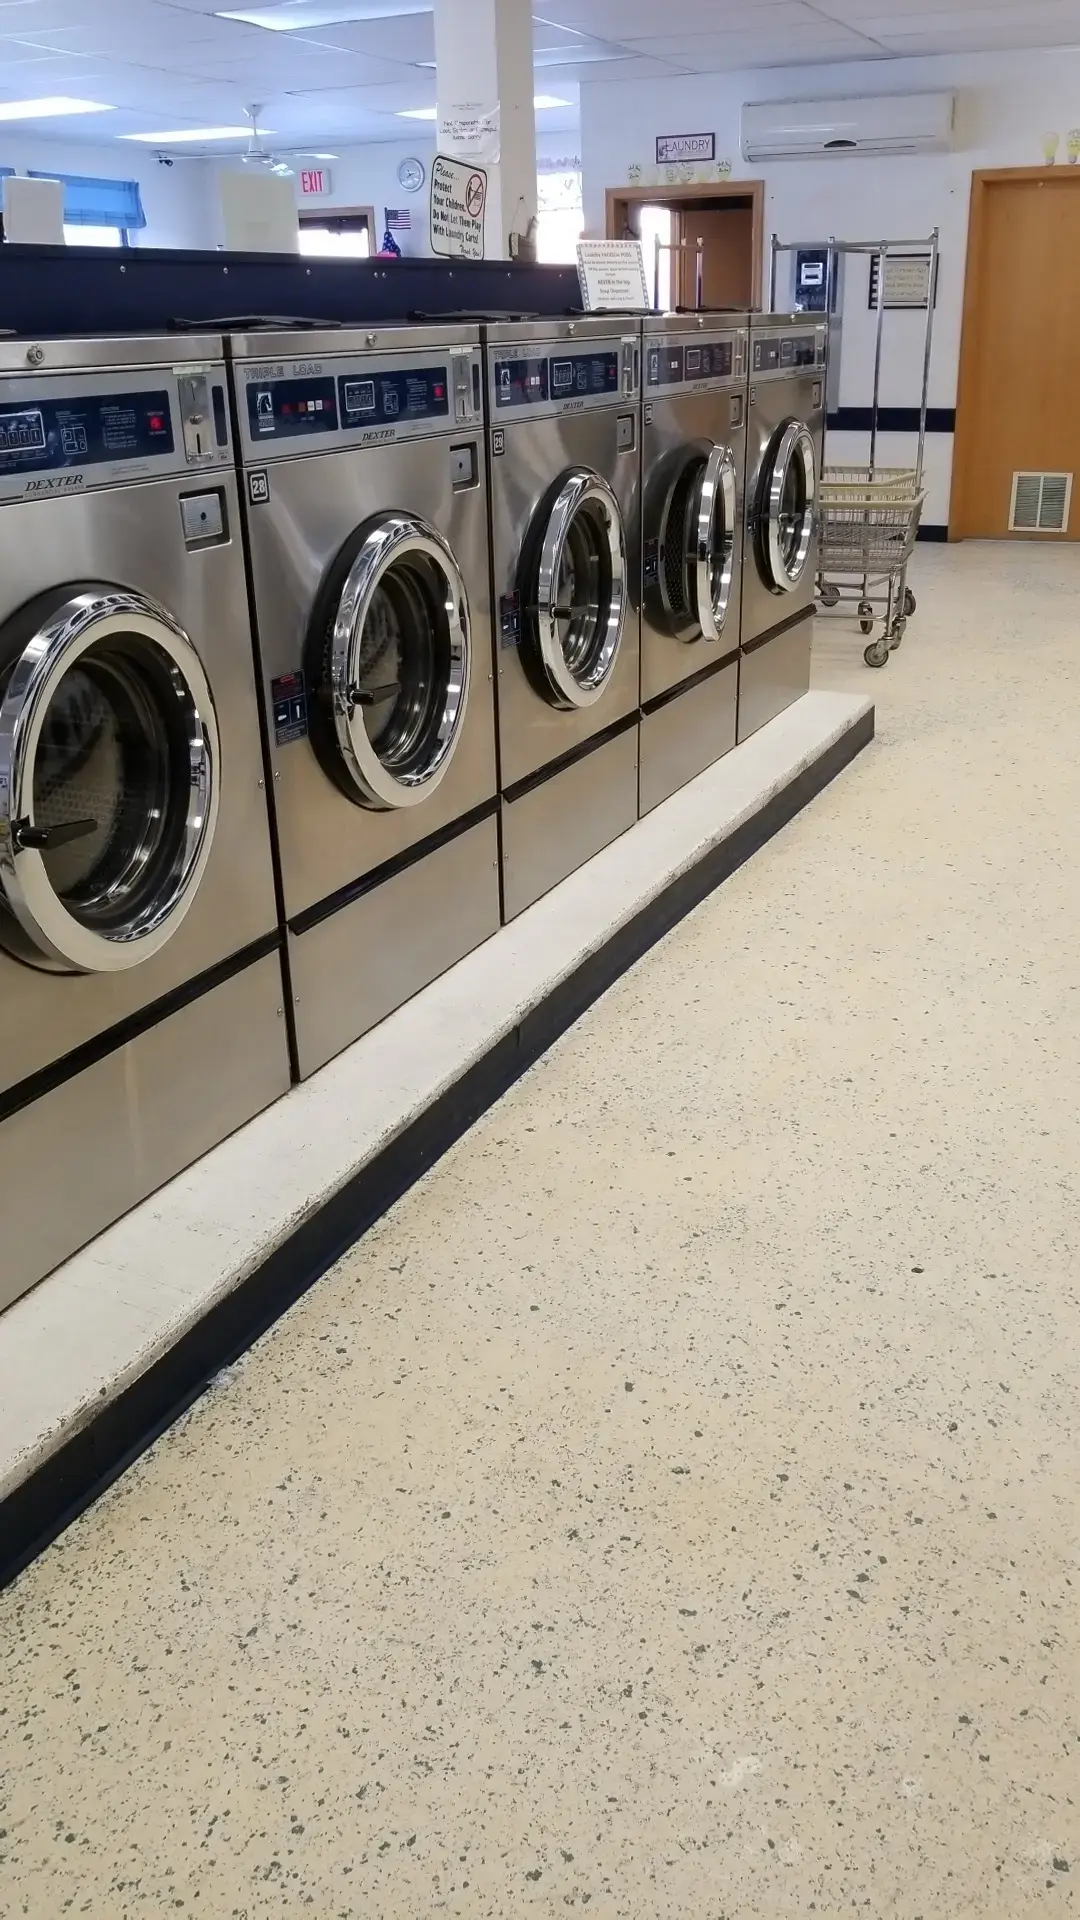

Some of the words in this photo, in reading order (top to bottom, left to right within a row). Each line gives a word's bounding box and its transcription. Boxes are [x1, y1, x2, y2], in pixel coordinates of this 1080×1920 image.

[666, 139, 710, 152] LAUNDRY
[302, 171, 322, 192] EXIT
[434, 179, 452, 194] Protect
[434, 194, 444, 206] Your
[432, 209, 440, 220] Do
[440, 211, 449, 222] Not
[459, 216, 471, 228] Them
[472, 218, 482, 232] Play
[433, 224, 444, 236] With
[446, 226, 464, 242] Laundry
[465, 232, 478, 244] Carts!
[460, 244, 470, 254] Thank
[244, 366, 284, 379] TRIPLE
[293, 364, 322, 376] LOAD
[362, 429, 395, 440] DEXTER
[25, 474, 84, 492] DEXTER
[252, 479, 266, 495] 28
